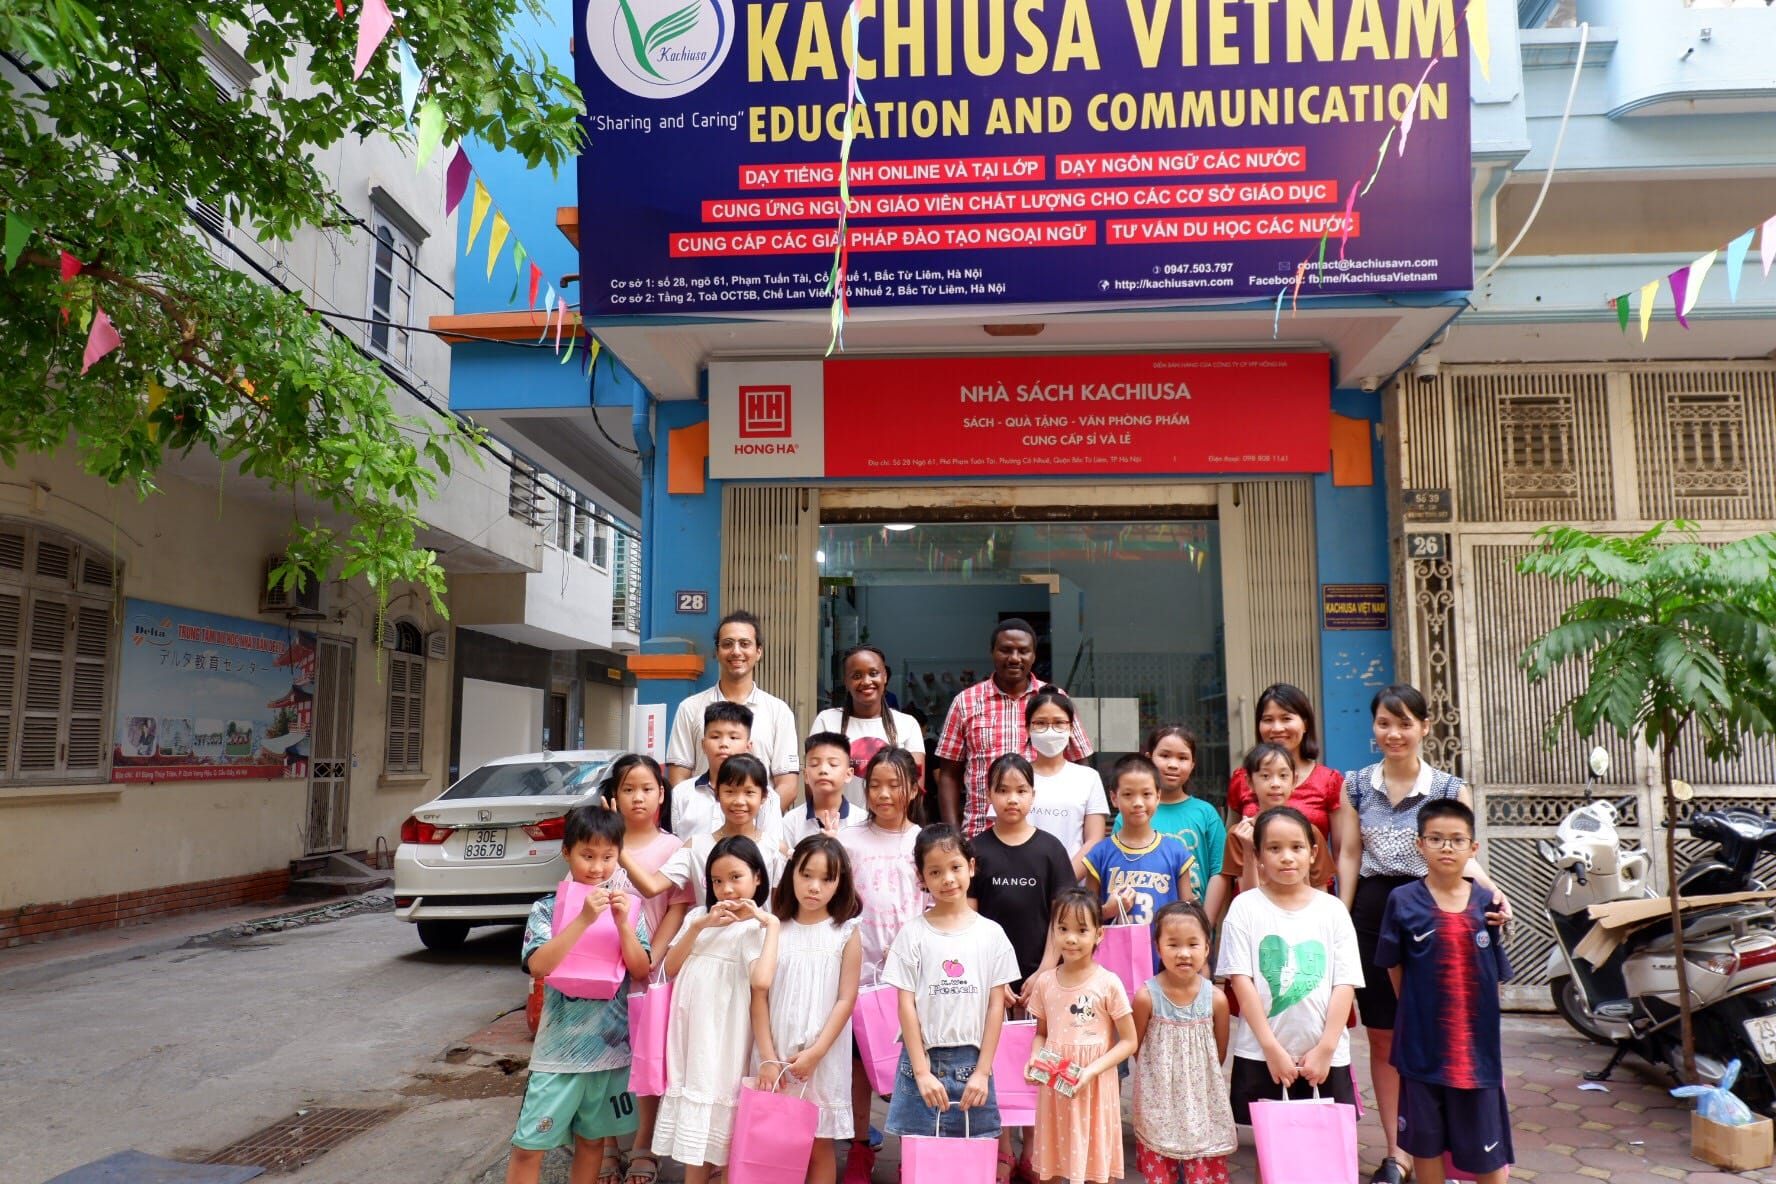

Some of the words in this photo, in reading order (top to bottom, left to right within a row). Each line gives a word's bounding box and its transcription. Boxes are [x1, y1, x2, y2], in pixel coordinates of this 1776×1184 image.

[748, 0, 1101, 82] KACHIUSA
[1126, 0, 1458, 68] VIETNAM
[656, 46, 708, 63] Kachiusa
[659, 113, 684, 129] and
[749, 100, 969, 143] EDUCATION
[985, 96, 1072, 135] AND
[1087, 82, 1448, 131] COMMUNICATION
[745, 170, 779, 187] DẠY
[784, 166, 834, 183] TIẾNG
[838, 167, 874, 182] NH
[878, 164, 940, 180] ONLINE
[944, 161, 968, 178] VÀ
[972, 162, 998, 180] TẠI
[1003, 158, 1038, 176] LỚP
[1061, 159, 1097, 177] DẠY
[1102, 155, 1153, 173] NGÔN
[1158, 153, 1199, 171] NGỮ
[1203, 152, 1240, 169] CÁC
[1246, 150, 1300, 168] NƯỚC
[712, 203, 761, 218] CUNG
[766, 199, 804, 216] ỨNG
[877, 196, 920, 213] GIÁO
[924, 194, 964, 211] VIÊN
[969, 192, 1016, 210] CHẤT
[1021, 193, 1085, 211] LƯỢNG
[1090, 191, 1129, 206] CHO
[1133, 187, 1170, 204] CÁC
[1176, 188, 1203, 203] CƠ
[1208, 185, 1235, 202] SỞ
[1239, 184, 1283, 201] GIÁO
[1289, 184, 1326, 202] DỤC
[1112, 224, 1138, 239] TƯ
[1142, 220, 1177, 238] VẤN
[1183, 222, 1207, 236] DU
[1213, 220, 1251, 238] HỌC
[1256, 216, 1294, 234] CÁC
[678, 238, 726, 252] CUNG
[731, 233, 766, 249] CẤP
[771, 232, 807, 249] CÁC
[851, 229, 898, 247] PHÁP
[902, 228, 940, 245] ĐÀO
[945, 229, 980, 246] TẠO
[986, 227, 1041, 244] NGOẠI
[1047, 224, 1087, 241] NGỮ
[610, 279, 626, 288] Cơ
[628, 278, 643, 288] sở
[645, 279, 655, 287] 1:
[657, 276, 671, 287] số
[673, 278, 688, 288] 28,
[691, 276, 711, 288] ngõ
[713, 276, 729, 287] 61,
[731, 275, 761, 287] Phạm
[764, 272, 790, 284] Tuấn
[792, 273, 812, 285] Tài,
[862, 272, 871, 283] 1,
[874, 269, 895, 281] Bắc
[897, 270, 913, 279] Từ
[915, 269, 944, 281] Liêm,
[947, 269, 961, 279] Hà
[964, 268, 983, 280] Nội
[1164, 263, 1233, 274] 0947.503.797
[610, 294, 626, 303] Cơ
[628, 293, 643, 303] sở
[645, 294, 655, 303] 2:
[658, 291, 684, 304] Tầng
[686, 293, 696, 303] 2,
[720, 290, 760, 301] OCT5B,
[762, 288, 783, 299] Chế
[786, 288, 806, 298] Lan
[855, 284, 883, 296] Nhuế
[885, 287, 895, 297] 2,
[898, 284, 918, 295] Bắc
[921, 284, 937, 294] Từ
[939, 283, 968, 295] Liêm,
[970, 283, 985, 293] Hà
[988, 283, 1006, 295] Nội
[1114, 277, 1234, 291] http://kachiusavn.com
[960, 380, 1010, 402] NHÀ
[1016, 380, 1074, 402] SÁCH
[1081, 382, 1192, 401] KACHIUSA
[963, 415, 994, 428] SÁCH
[1005, 414, 1032, 427] QUÀ
[1035, 415, 1068, 429] TẶNG
[1079, 414, 1105, 426] VĂN
[1108, 413, 1152, 426] PHÒNG
[1155, 412, 1190, 425] PHẨM
[1022, 436, 1057, 446] CUNG
[1060, 432, 1083, 445] CẤP
[1100, 432, 1116, 444] VÀ
[1119, 432, 1131, 444] LẺ
[734, 444, 774, 454] HONG
[1414, 536, 1438, 555] 26
[680, 595, 703, 609] 28
[1326, 602, 1357, 613] KACHIUSA
[476, 831, 497, 843] 30E
[466, 844, 504, 857] 836.78
[992, 876, 1037, 886] MANGO
[1107, 867, 1171, 894] LAKERS
[609, 1091, 633, 1119] 10
